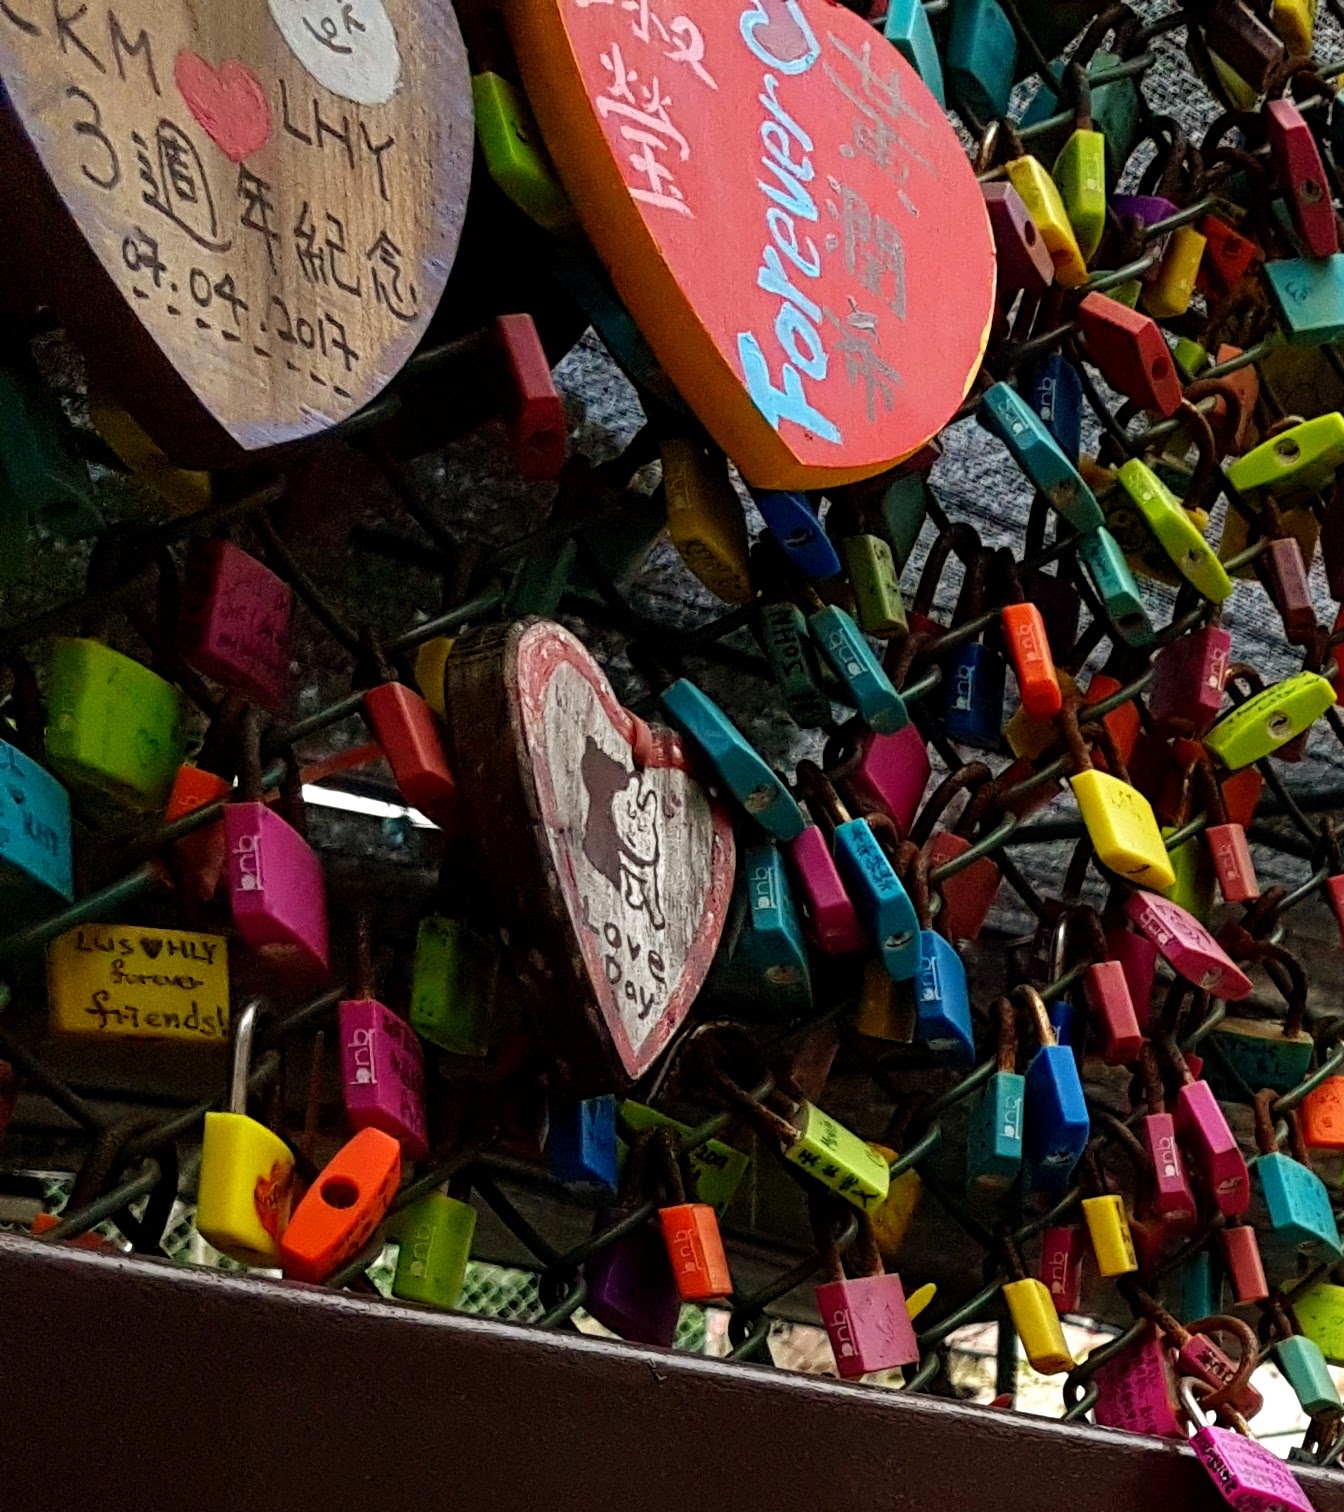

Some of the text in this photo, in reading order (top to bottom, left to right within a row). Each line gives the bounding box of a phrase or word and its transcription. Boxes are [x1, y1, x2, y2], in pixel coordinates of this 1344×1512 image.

[232, 835, 265, 891] bnb
[751, 866, 776, 911] bnb
[346, 1028, 378, 1085] bnb
[1000, 1096, 1022, 1140] bnb
[1157, 1136, 1180, 1177] bnb
[674, 1228, 702, 1272] bnb
[1048, 1251, 1068, 1294] bnb
[831, 1309, 860, 1358] bnb
